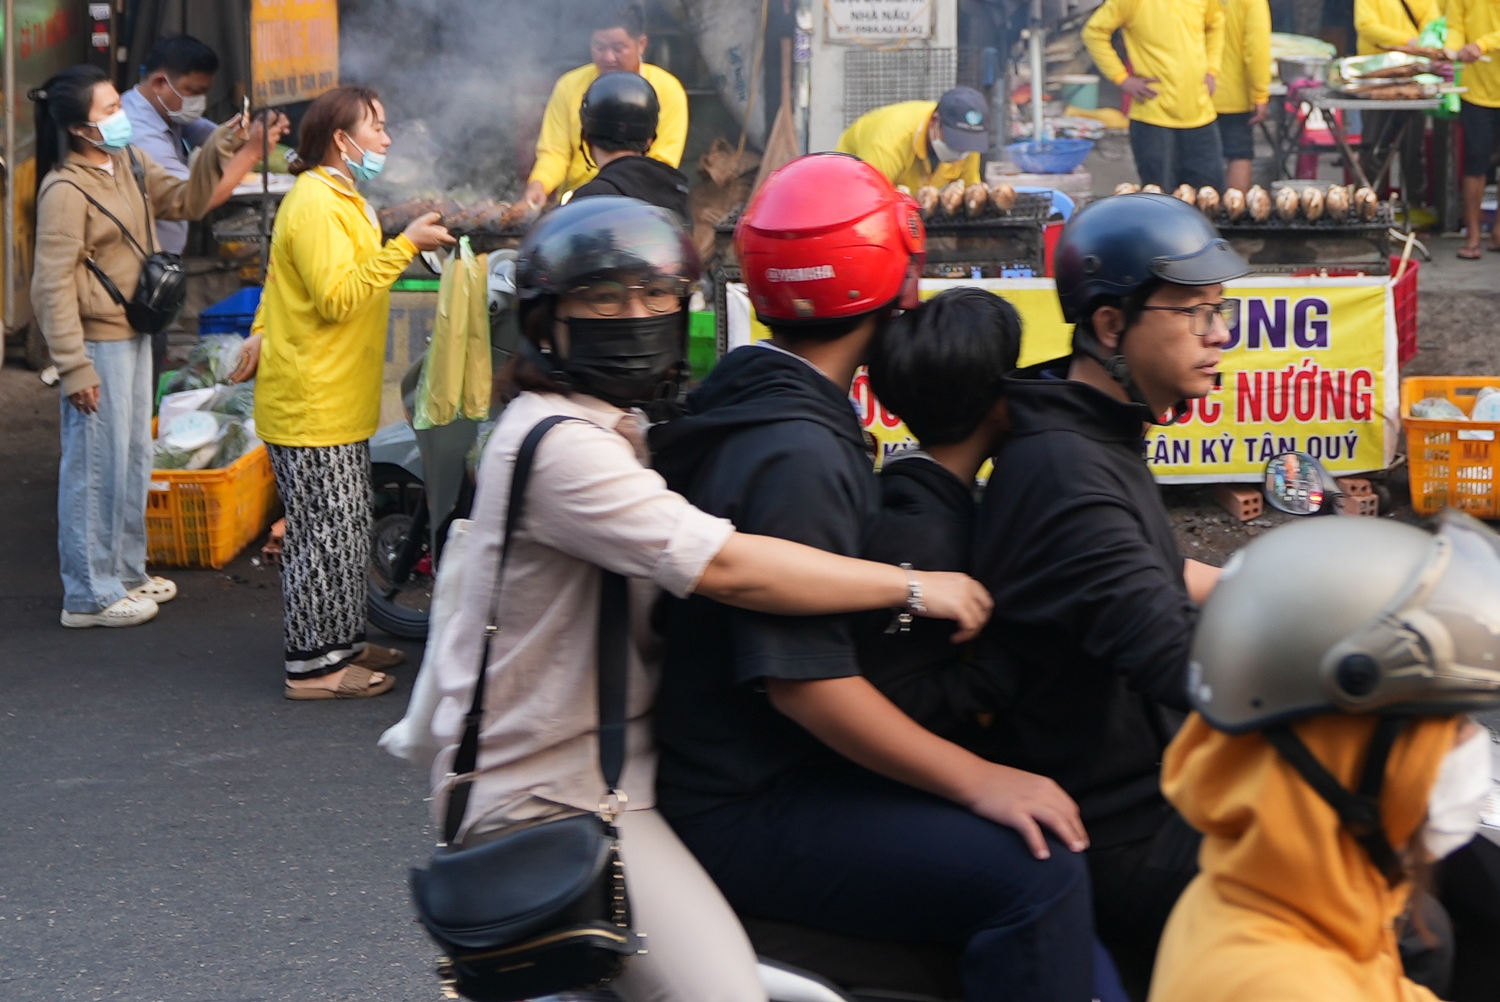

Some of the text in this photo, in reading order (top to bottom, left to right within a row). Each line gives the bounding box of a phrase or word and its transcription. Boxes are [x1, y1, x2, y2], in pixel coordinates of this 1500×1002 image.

[1221, 298, 1329, 350] UNG
[1237, 360, 1372, 423] NƯỚNG
[1202, 433, 1235, 464] KỲ
[1244, 432, 1296, 463] TÂN
[1307, 430, 1359, 461] QUÝ
